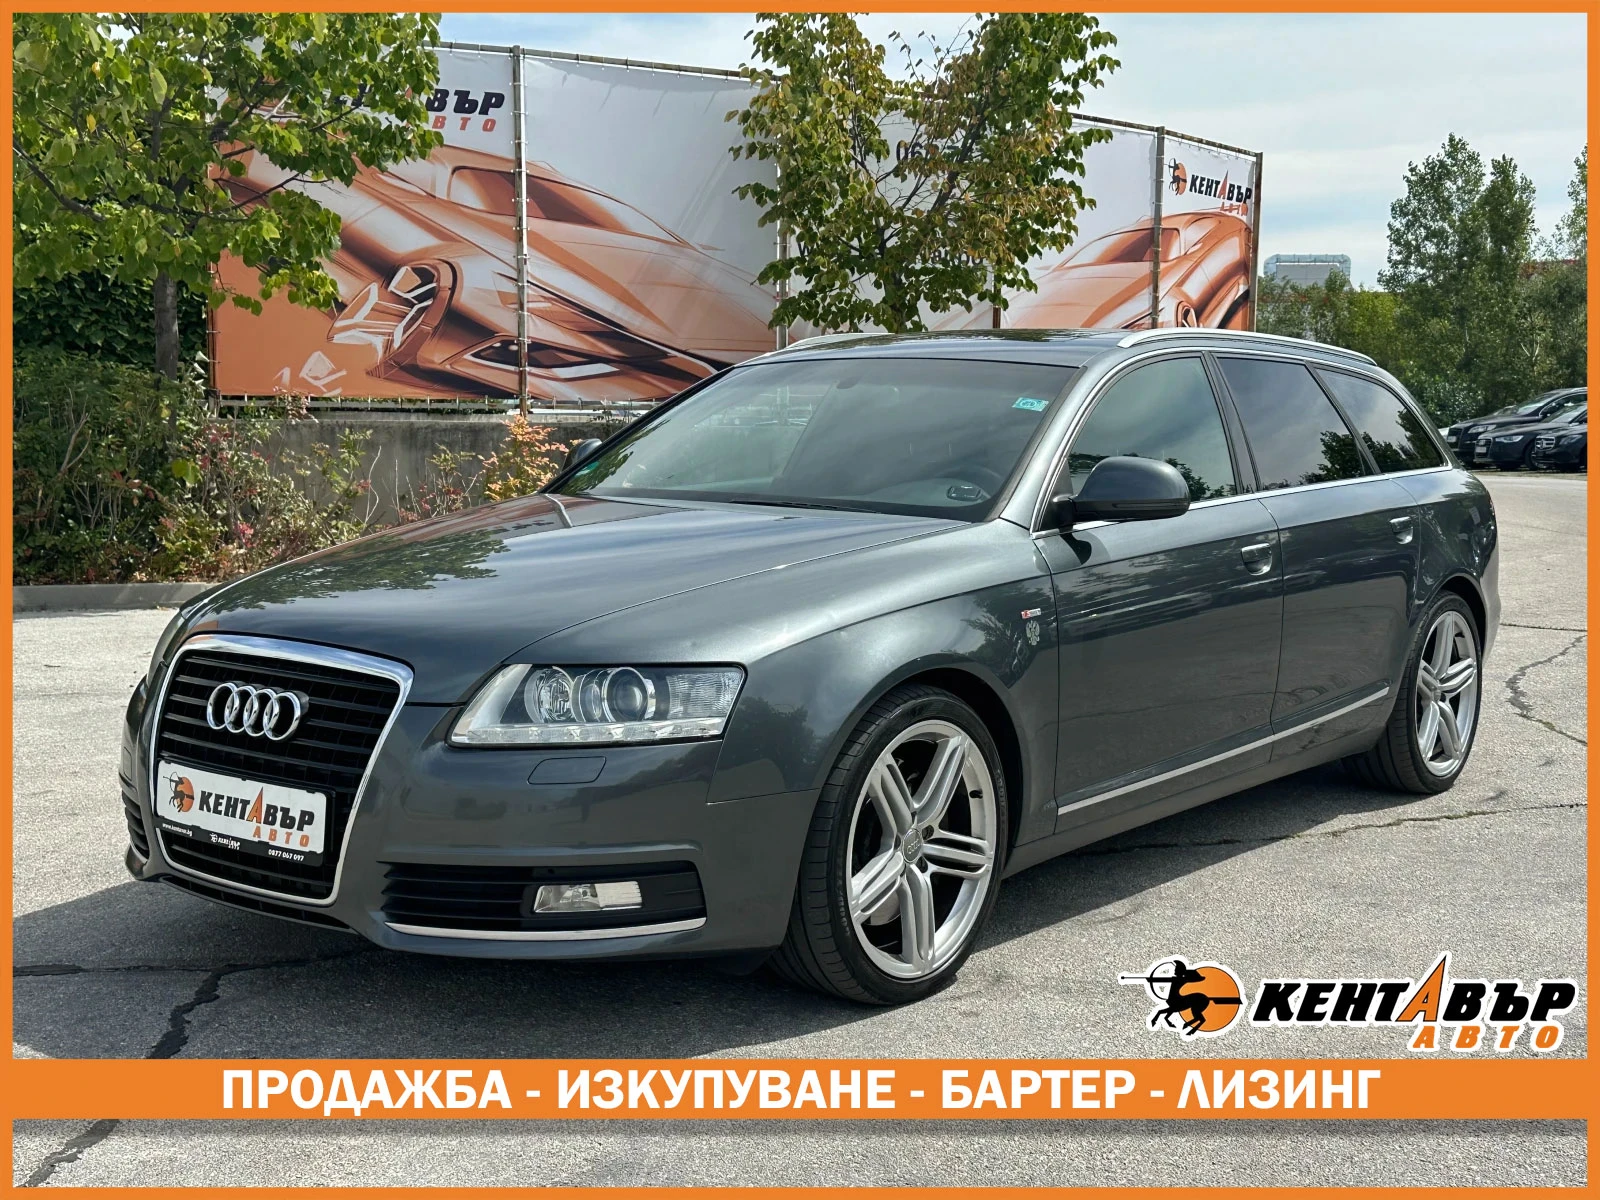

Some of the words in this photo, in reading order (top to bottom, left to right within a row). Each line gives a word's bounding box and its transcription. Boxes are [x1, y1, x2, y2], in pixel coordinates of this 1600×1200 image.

[408, 115, 497, 133] ВТО
[1189, 170, 1252, 204] КЕНТАВЪР
[199, 786, 315, 832] КЕНТАВЪР
[253, 826, 310, 848] АВТО
[267, 848, 282, 857] 0877
[282, 850, 294, 860] 067
